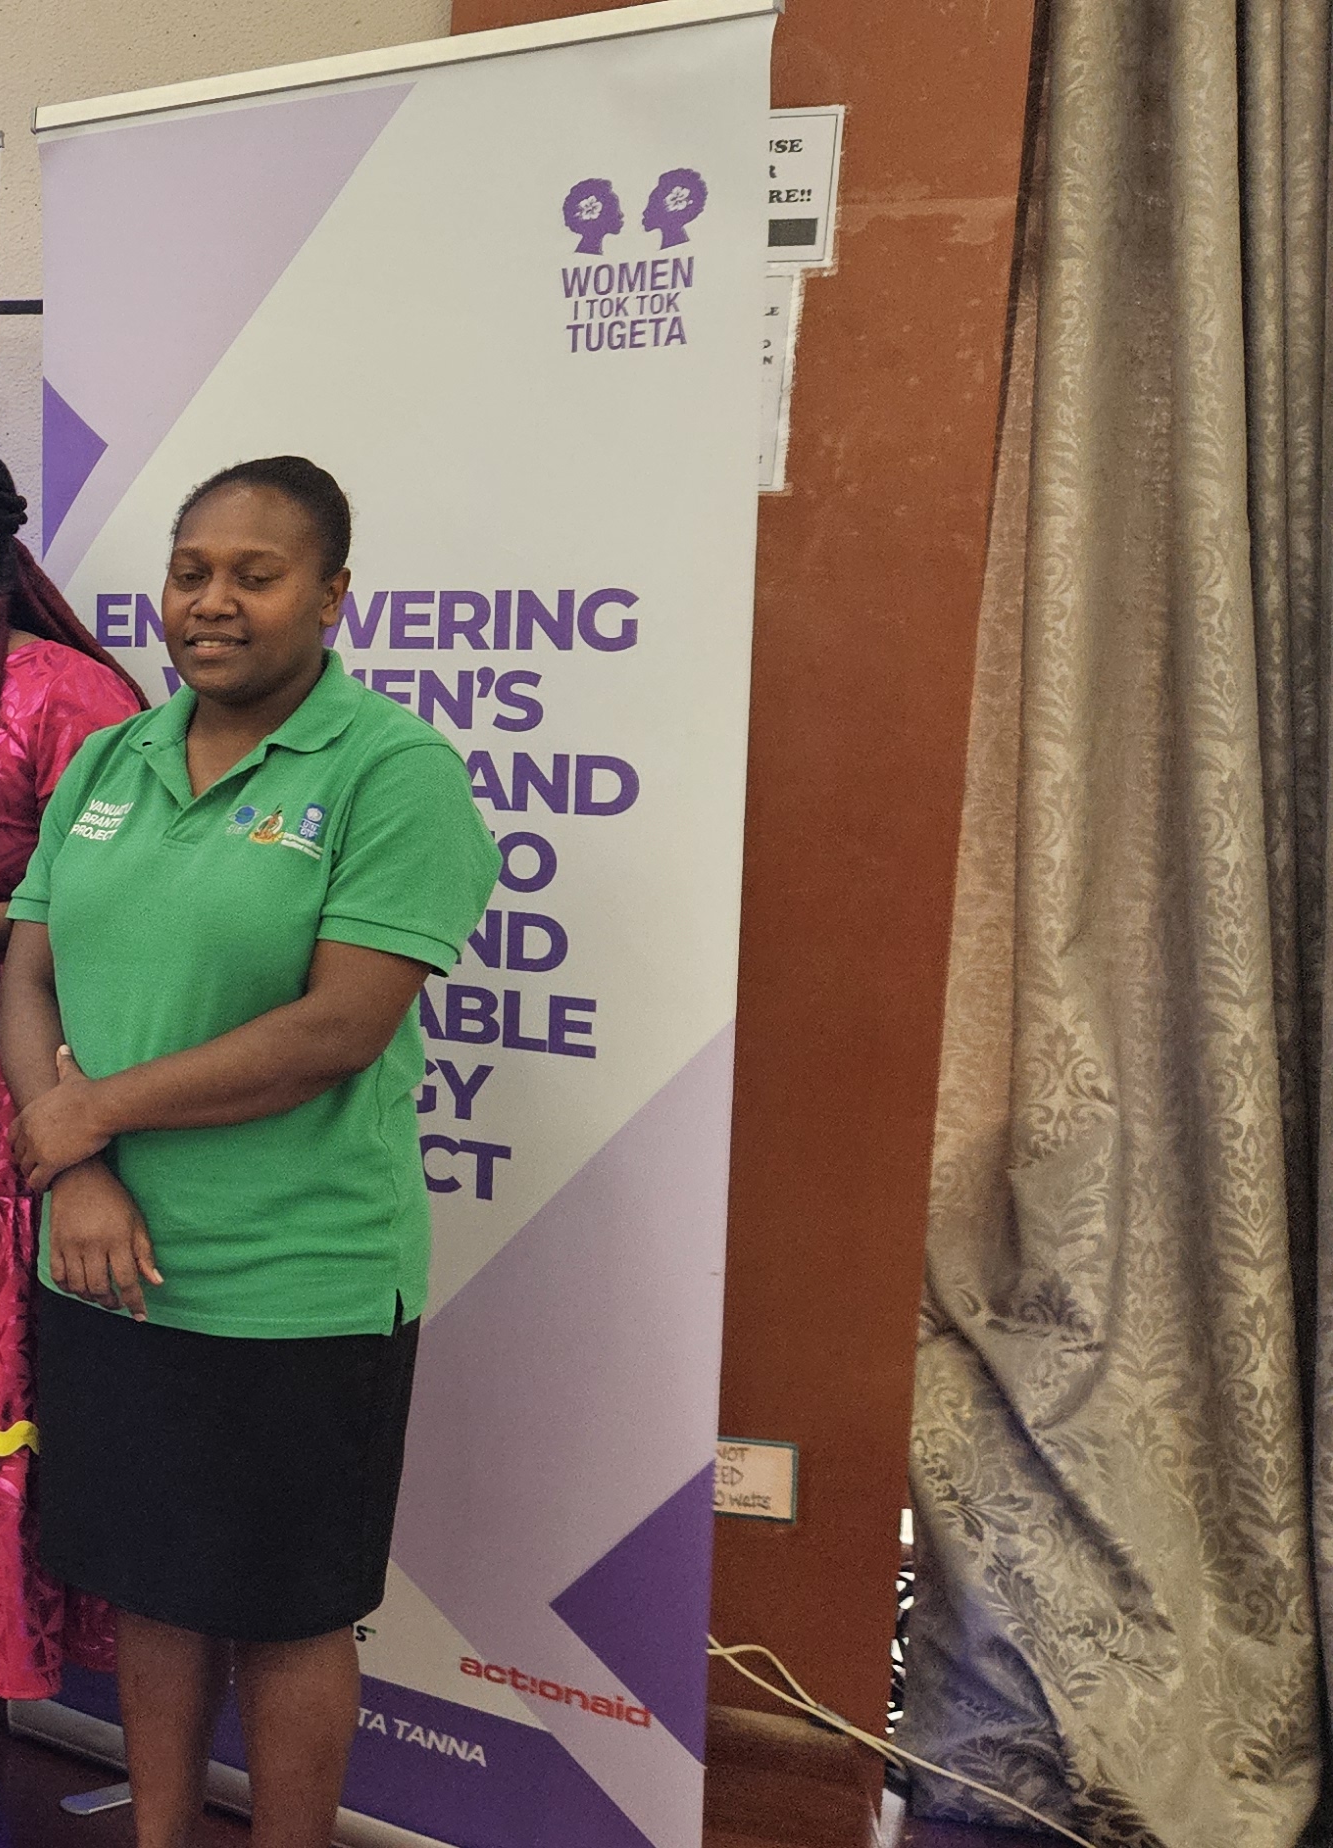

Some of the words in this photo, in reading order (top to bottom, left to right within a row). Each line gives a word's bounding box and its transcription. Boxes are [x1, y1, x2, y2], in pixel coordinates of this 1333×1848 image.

[561, 256, 694, 298] WOMEN
[573, 300, 579, 321] I
[586, 296, 629, 319] TOK
[636, 291, 681, 315] TOK
[566, 316, 687, 353] TUGETA
[96, 588, 640, 652] EMWERING
[465, 750, 640, 816] AND
[69, 824, 118, 841] PROJECT
[491, 830, 557, 893] O
[393, 1717, 487, 1767] TANNA
